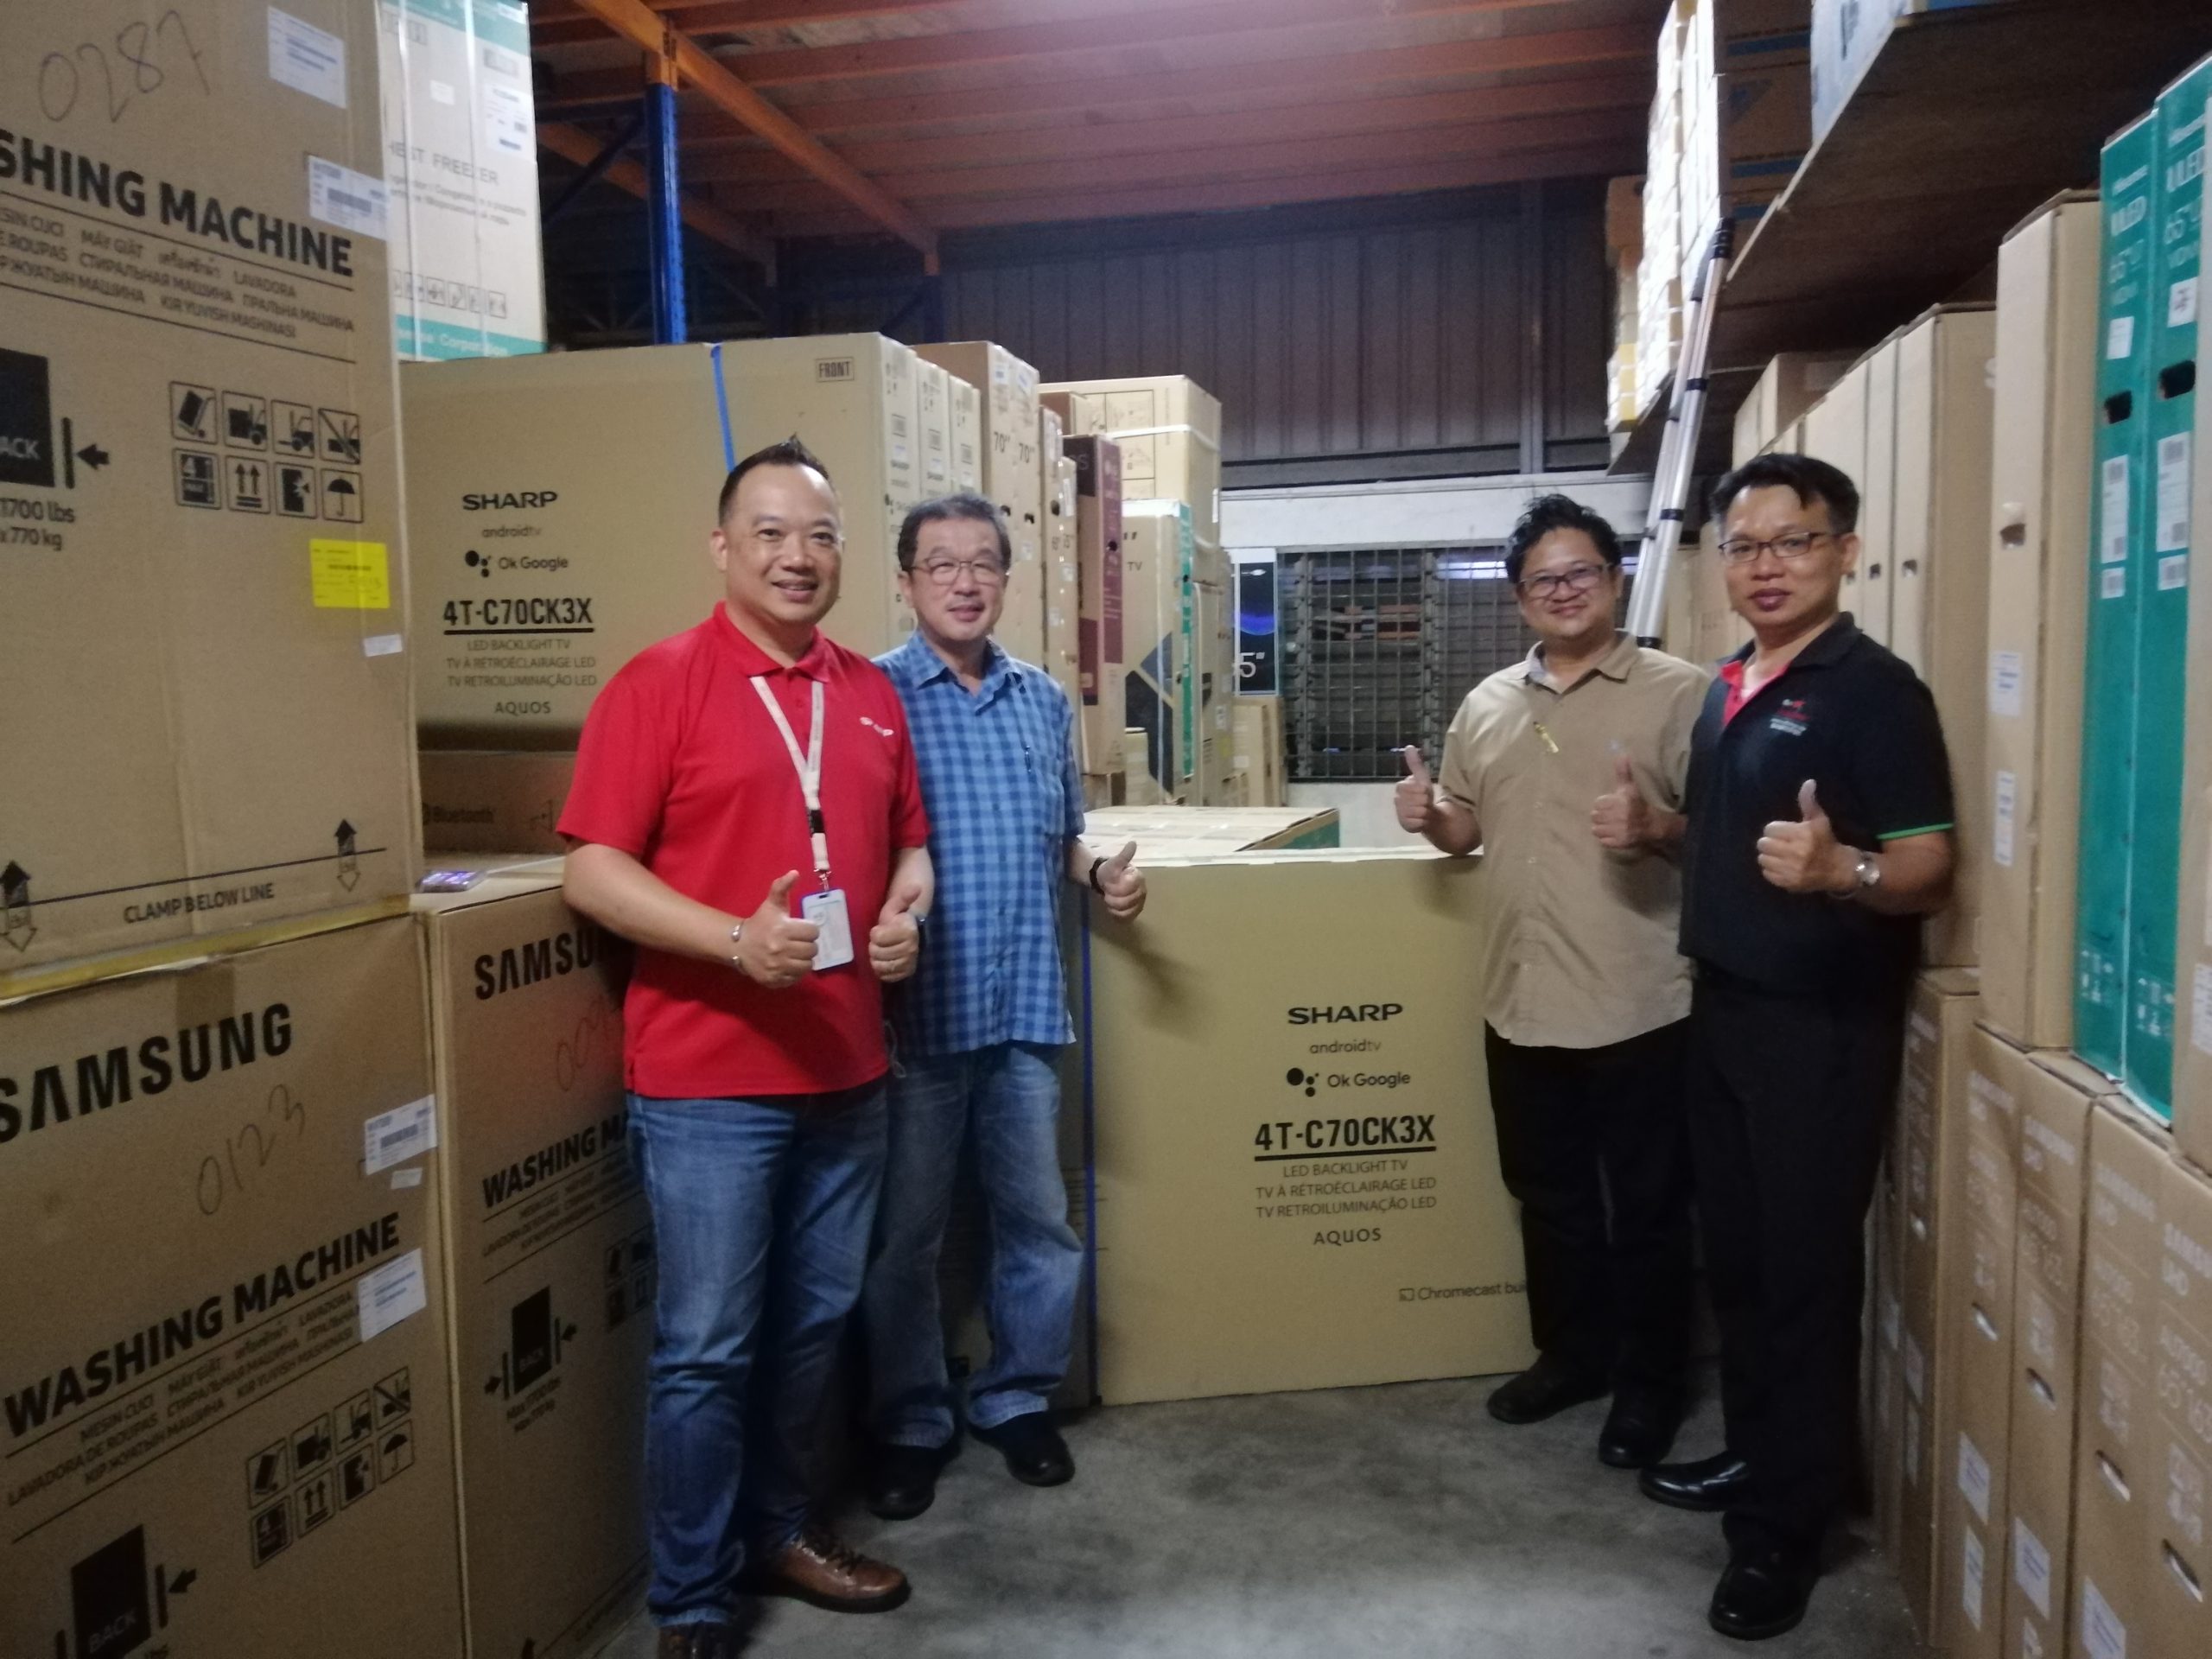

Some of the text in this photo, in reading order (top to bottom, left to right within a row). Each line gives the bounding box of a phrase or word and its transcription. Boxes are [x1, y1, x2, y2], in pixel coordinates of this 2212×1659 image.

[38, 10, 210, 122] 0287
[159, 181, 353, 276] MACHINE
[819, 361, 850, 378] FRONT
[47, 499, 75, 523] lbs
[461, 491, 558, 511] SHARP
[10, 525, 40, 546] 770
[43, 529, 63, 551] kg
[497, 555, 569, 572] Ok Google
[1128, 562, 1143, 571] TV
[442, 597, 594, 626] 4T-C70CK3X
[467, 639, 571, 652] LED BACKLIGHT TV
[447, 658, 461, 670] TV
[463, 655, 471, 669] À
[574, 657, 595, 668] LED
[448, 676, 461, 688] TV
[575, 675, 596, 686] LED
[494, 701, 551, 715] AQUOS
[124, 882, 276, 924] CLAMP BELOW LINE
[474, 925, 603, 1001] SAMSU
[1287, 1003, 1404, 1026] SHARP
[0, 1002, 292, 1144] SAMSUNG
[1326, 1071, 1412, 1090] Ok Google
[1254, 1114, 1436, 1152] 4T-C70CK3X
[197, 1084, 305, 1216] 0123
[482, 1126, 596, 1209] WASHING
[601, 1109, 629, 1150] M
[1283, 1159, 1408, 1178] LED BACKLIGHT TV
[1255, 1177, 1437, 1199] TV À RÉTROÉCLAIRAGE LED
[1255, 1196, 1437, 1218] TV RETROILUMINAÇÃO LED
[1313, 1227, 1382, 1246] AQUOS
[1418, 1282, 1502, 1300] Chromecast
[4, 1296, 224, 1438] WASHING
[233, 1211, 400, 1324] MACHINE
[88, 1606, 138, 1654] BACK
